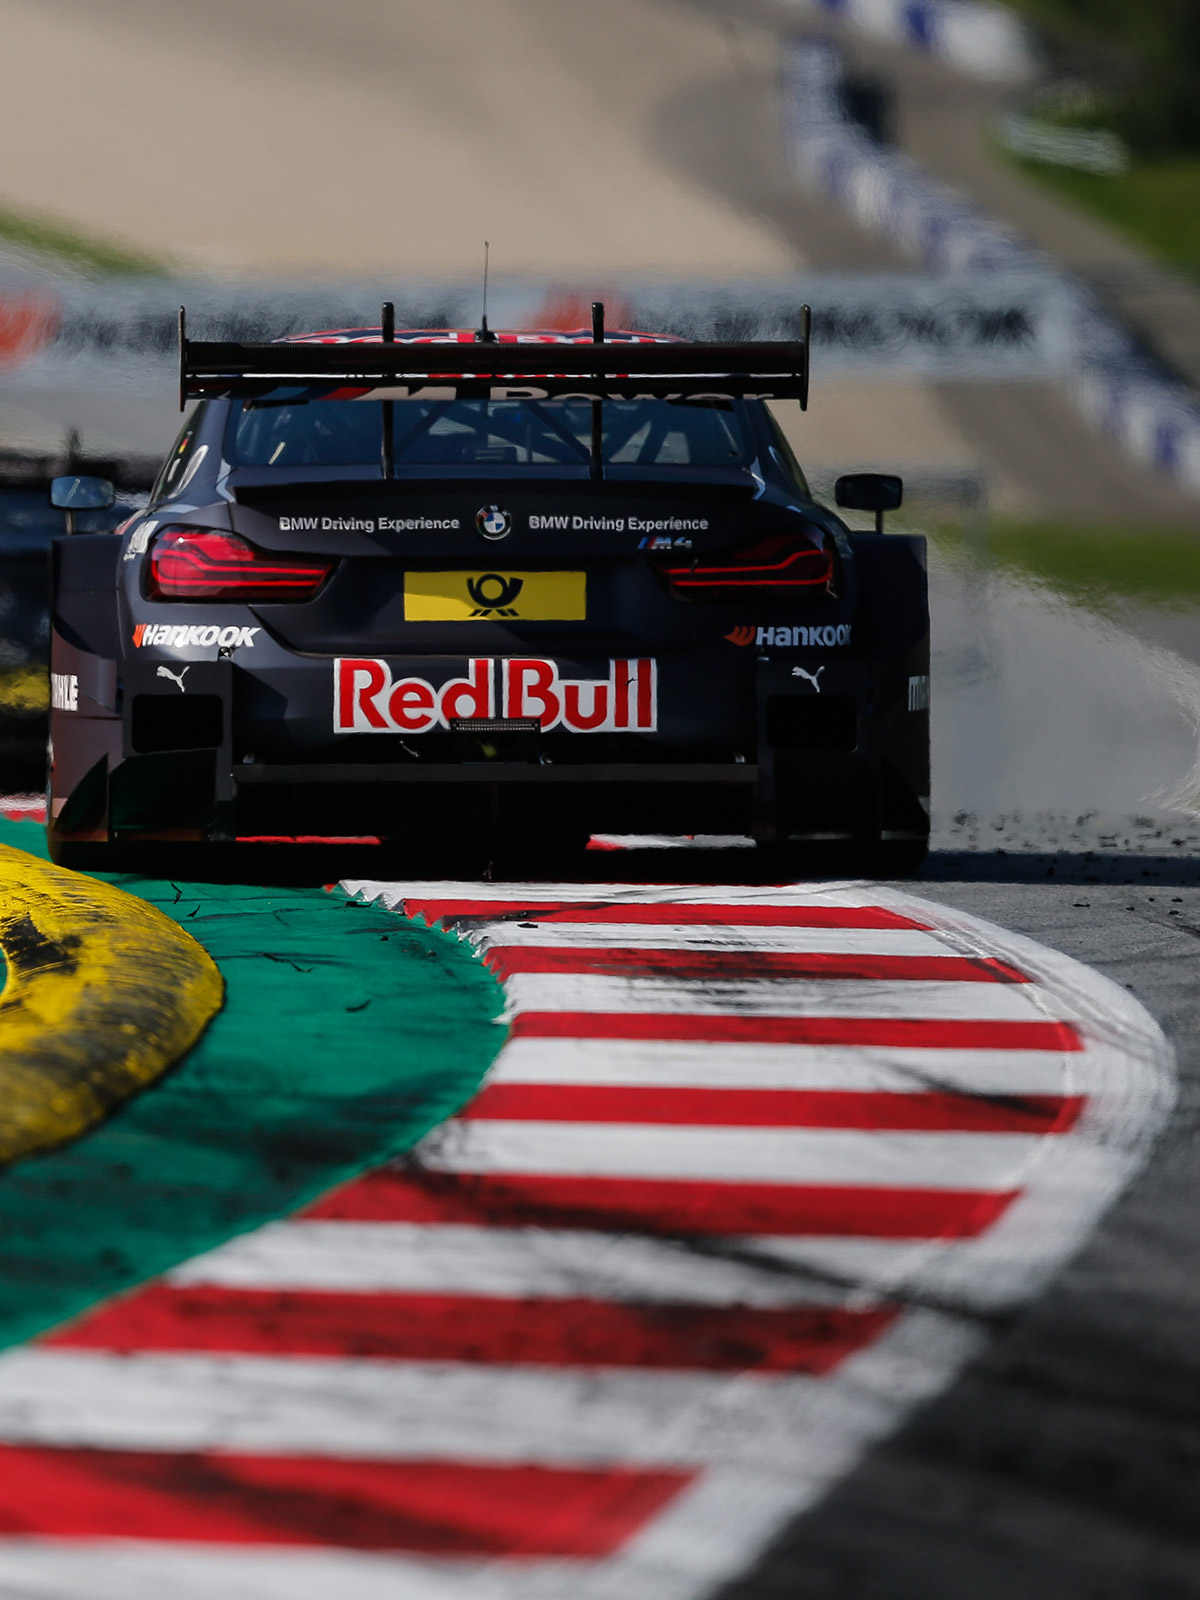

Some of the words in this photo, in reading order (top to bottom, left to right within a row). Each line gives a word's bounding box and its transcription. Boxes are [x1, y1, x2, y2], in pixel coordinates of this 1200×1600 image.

[279, 516, 318, 530] BMW
[322, 517, 374, 533] Driving
[378, 517, 460, 533] Experience
[528, 515, 569, 529] BMW
[572, 516, 624, 531] Driving
[628, 516, 709, 532] Experience
[333, 658, 496, 733] Red
[502, 658, 658, 733] Bull
